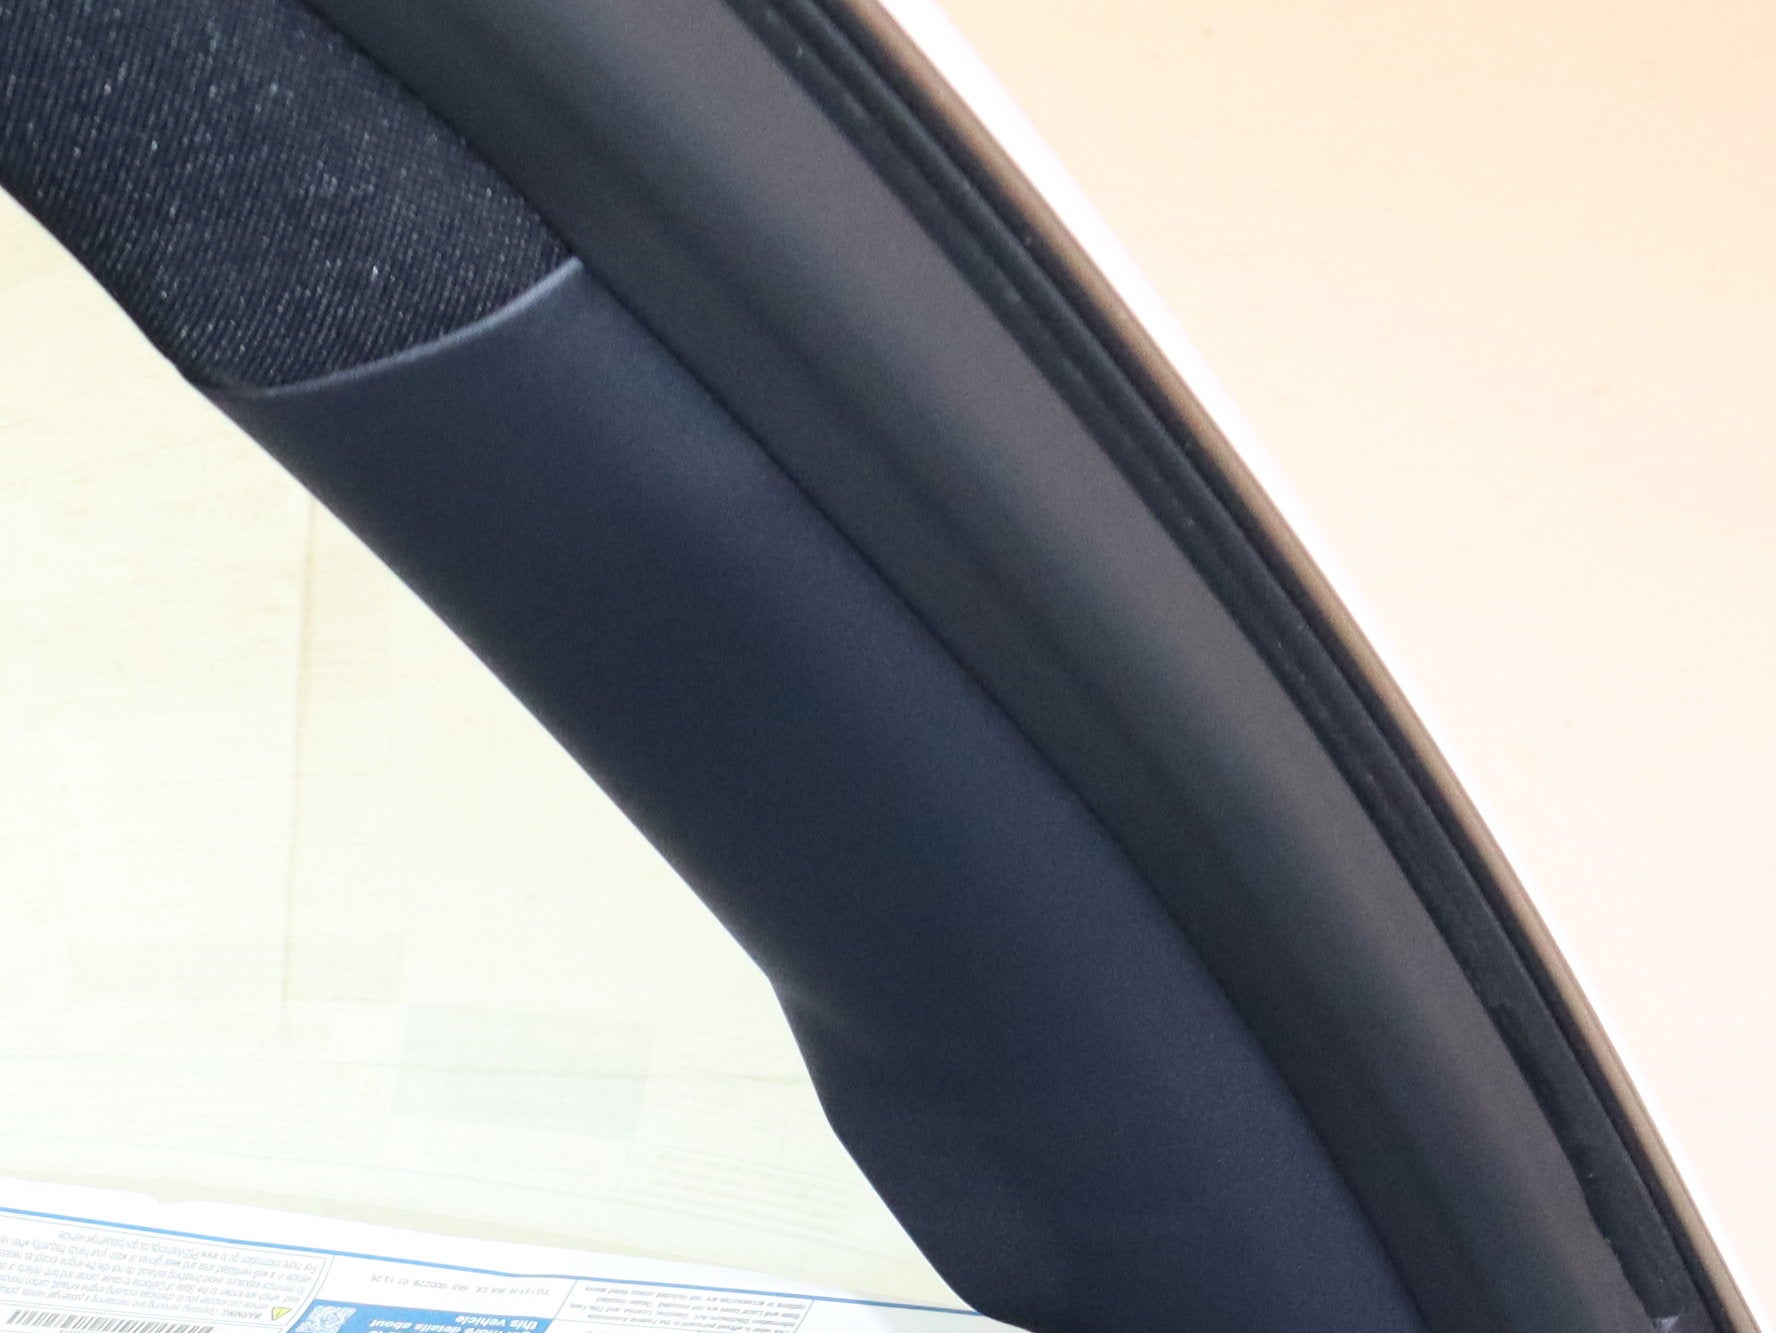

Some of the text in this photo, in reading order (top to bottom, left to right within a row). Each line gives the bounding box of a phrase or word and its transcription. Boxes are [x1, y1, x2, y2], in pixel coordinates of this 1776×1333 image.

[367, 1319, 413, 1329] about
[451, 1315, 541, 1329] this vehicle
[411, 1323, 463, 1333] details
